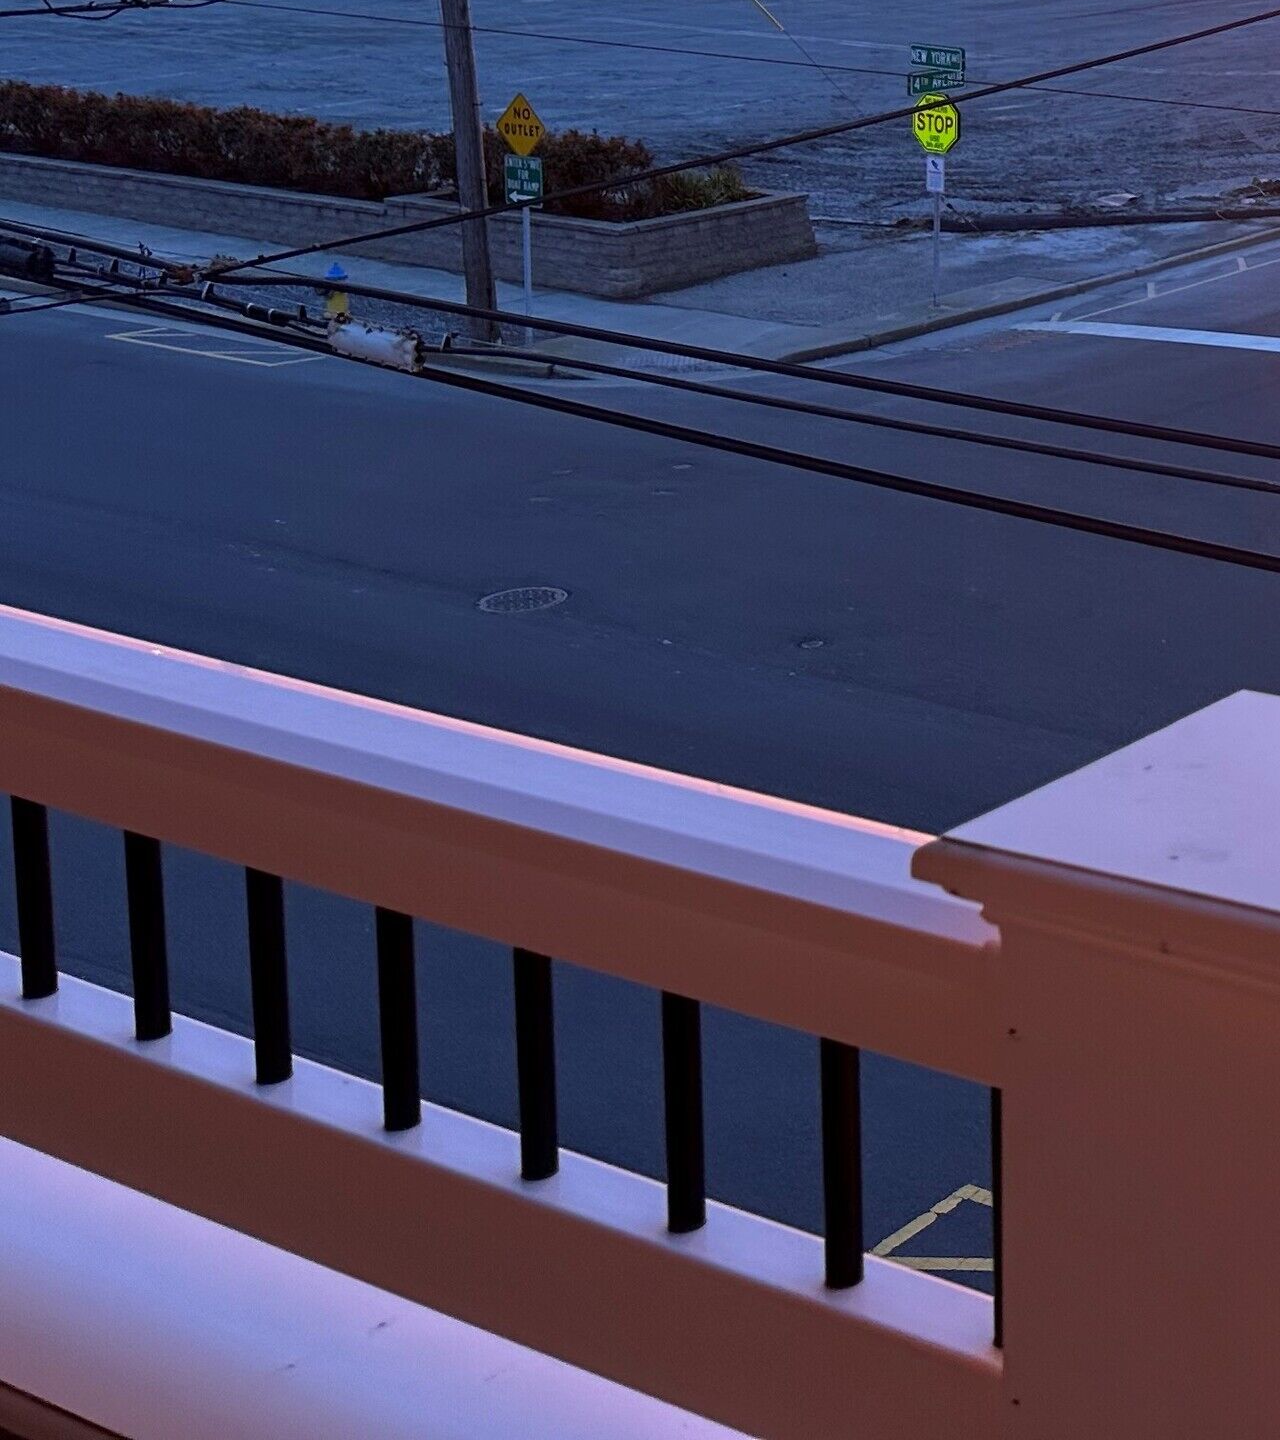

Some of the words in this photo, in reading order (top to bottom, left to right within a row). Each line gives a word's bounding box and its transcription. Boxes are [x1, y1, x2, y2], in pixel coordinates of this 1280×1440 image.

[911, 49, 927, 63] NEW
[931, 51, 951, 66] YORK
[513, 107, 531, 120] NO
[504, 123, 540, 137] OUTLET
[917, 112, 954, 135] STOP
